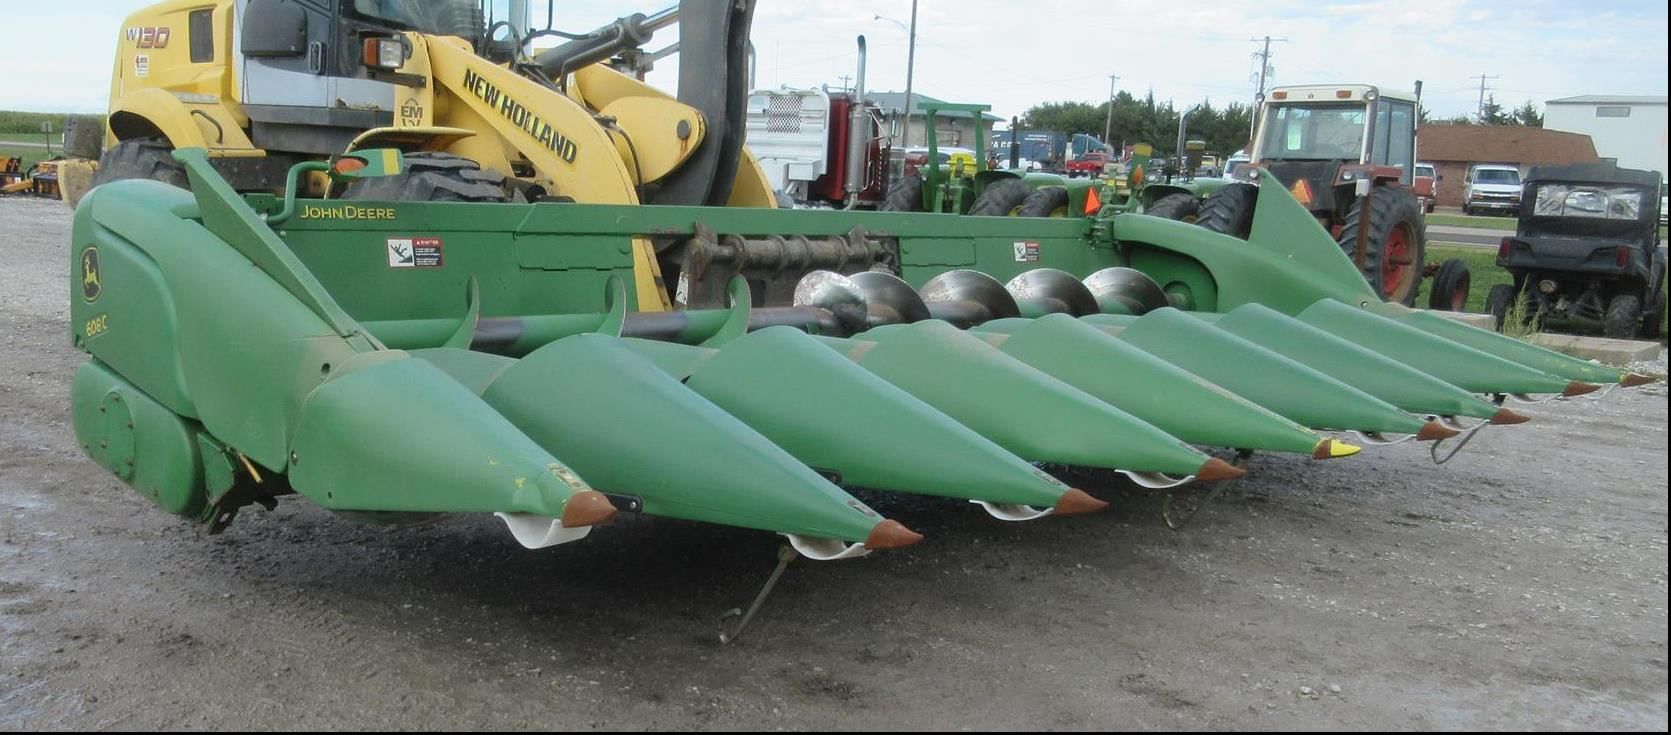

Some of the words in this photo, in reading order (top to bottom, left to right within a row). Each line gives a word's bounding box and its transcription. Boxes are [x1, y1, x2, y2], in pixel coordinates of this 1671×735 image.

[463, 68, 501, 109] NEW
[501, 94, 578, 165] HOLLAND
[300, 204, 343, 219] JOHN
[344, 205, 396, 220] DEERE
